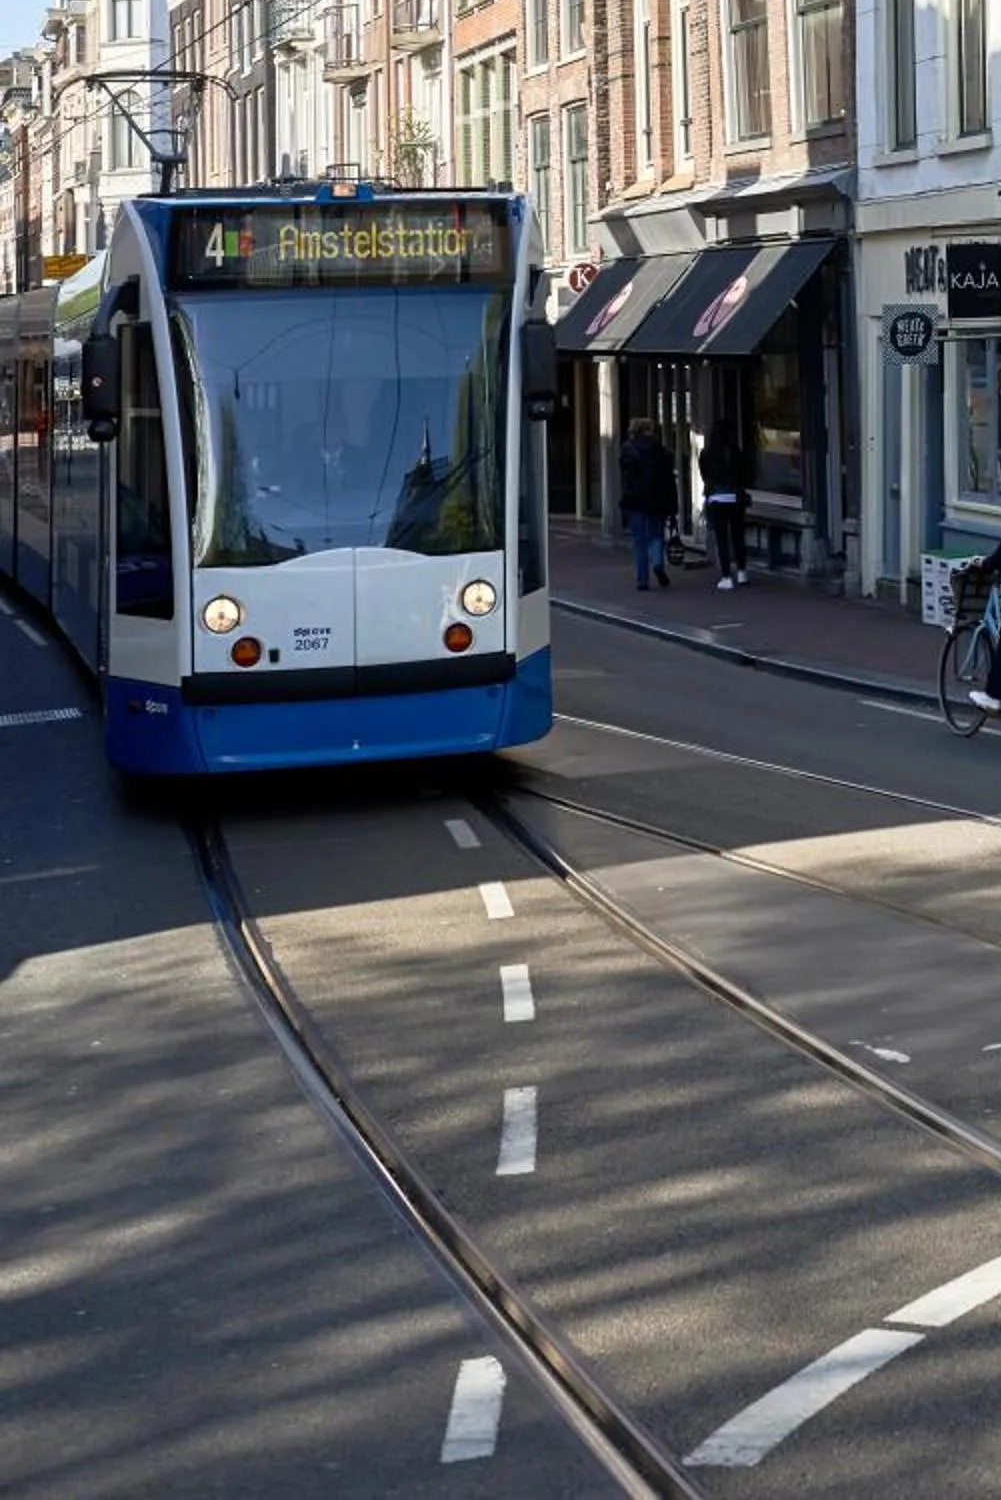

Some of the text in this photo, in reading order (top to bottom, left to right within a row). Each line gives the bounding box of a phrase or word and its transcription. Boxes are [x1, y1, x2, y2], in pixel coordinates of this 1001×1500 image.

[205, 222, 225, 267] 4
[576, 267, 591, 288] K
[950, 261, 999, 289] KAJA
[294, 637, 329, 651] 2067
